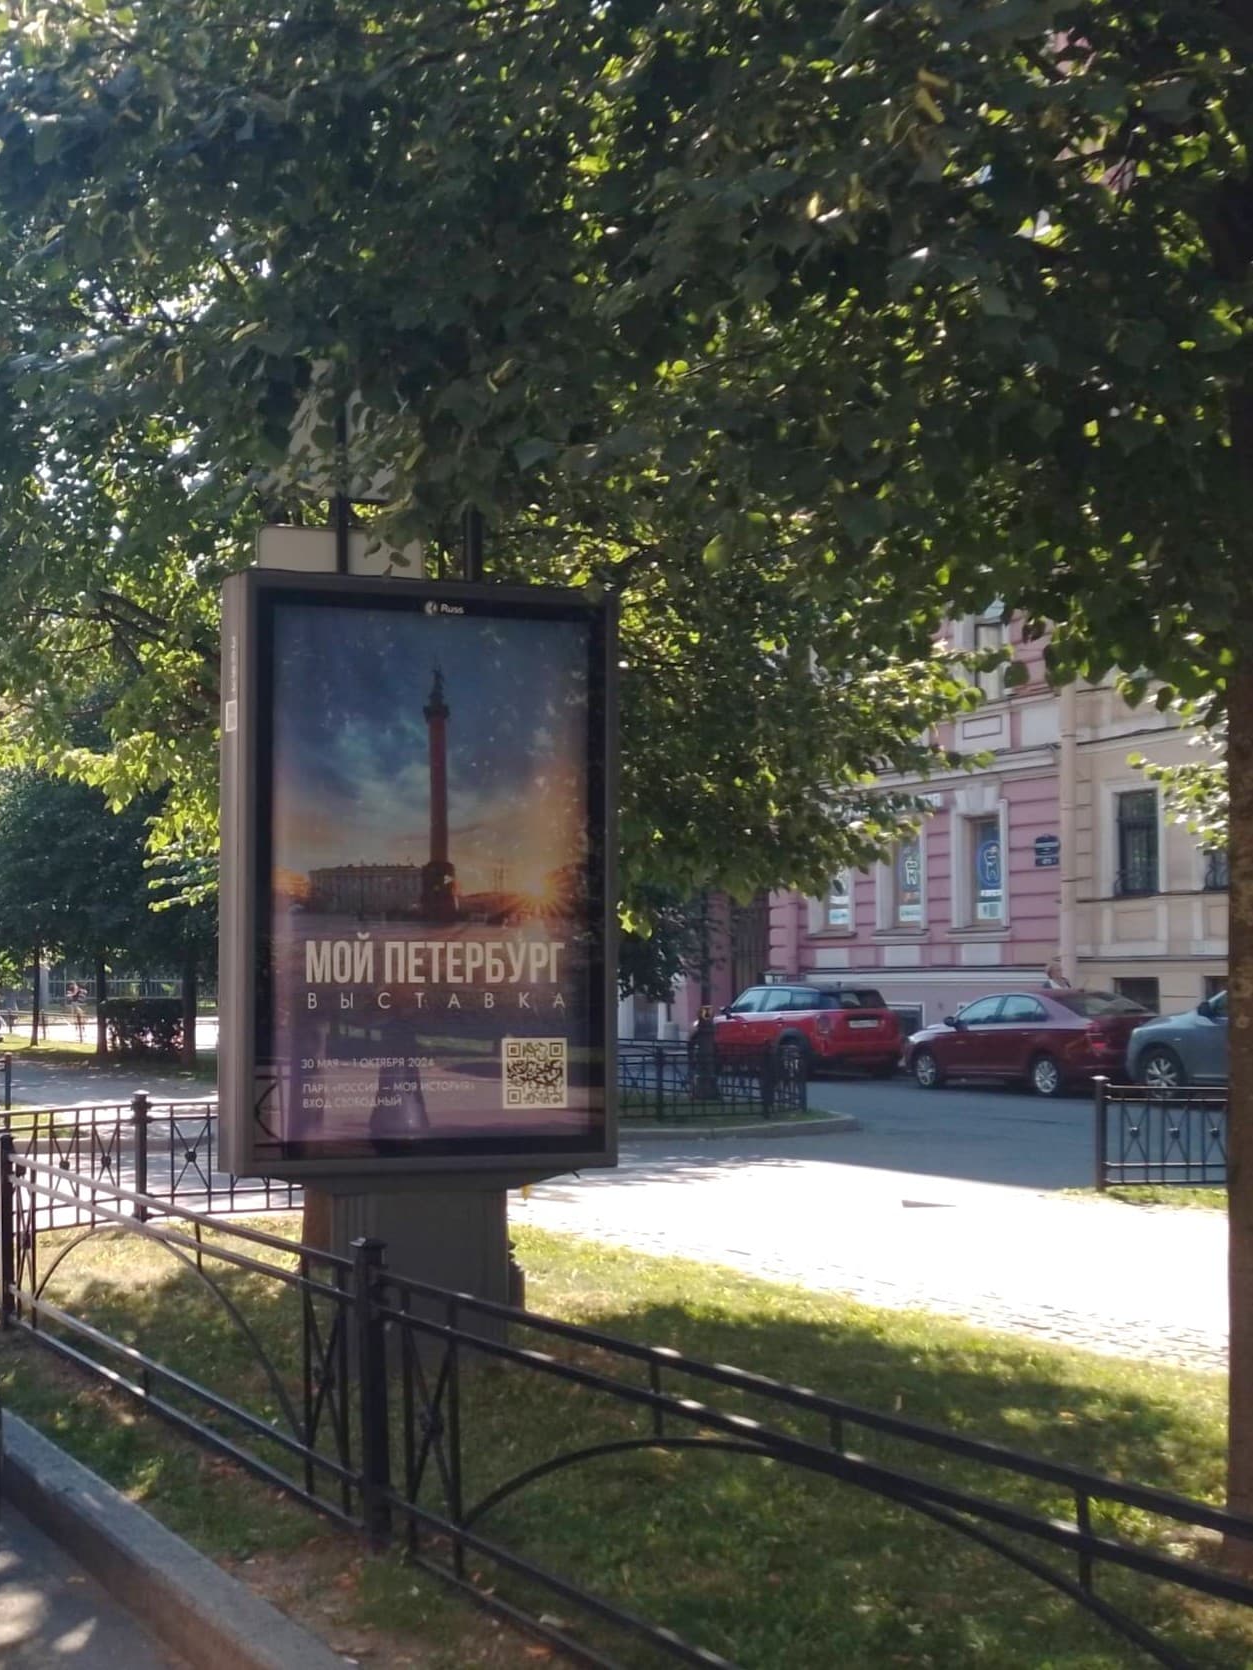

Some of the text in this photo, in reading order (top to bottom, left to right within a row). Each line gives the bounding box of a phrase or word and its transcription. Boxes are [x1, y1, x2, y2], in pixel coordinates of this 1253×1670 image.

[440, 603, 465, 614] Russ
[305, 931, 566, 984] МОЙ ПЕТЕРБУРГ
[307, 992, 566, 1009] ВЫСТАВКА
[300, 1058, 314, 1069] 30
[317, 1058, 339, 1069] МАЯ
[359, 1057, 405, 1068] ОКТЯБРЯ
[408, 1057, 435, 1068] 2024
[303, 1083, 329, 1094] ПАРК
[393, 1082, 418, 1092] МОЯ
[302, 1094, 402, 1109] ВХОД СВОБОДНЫЙ
